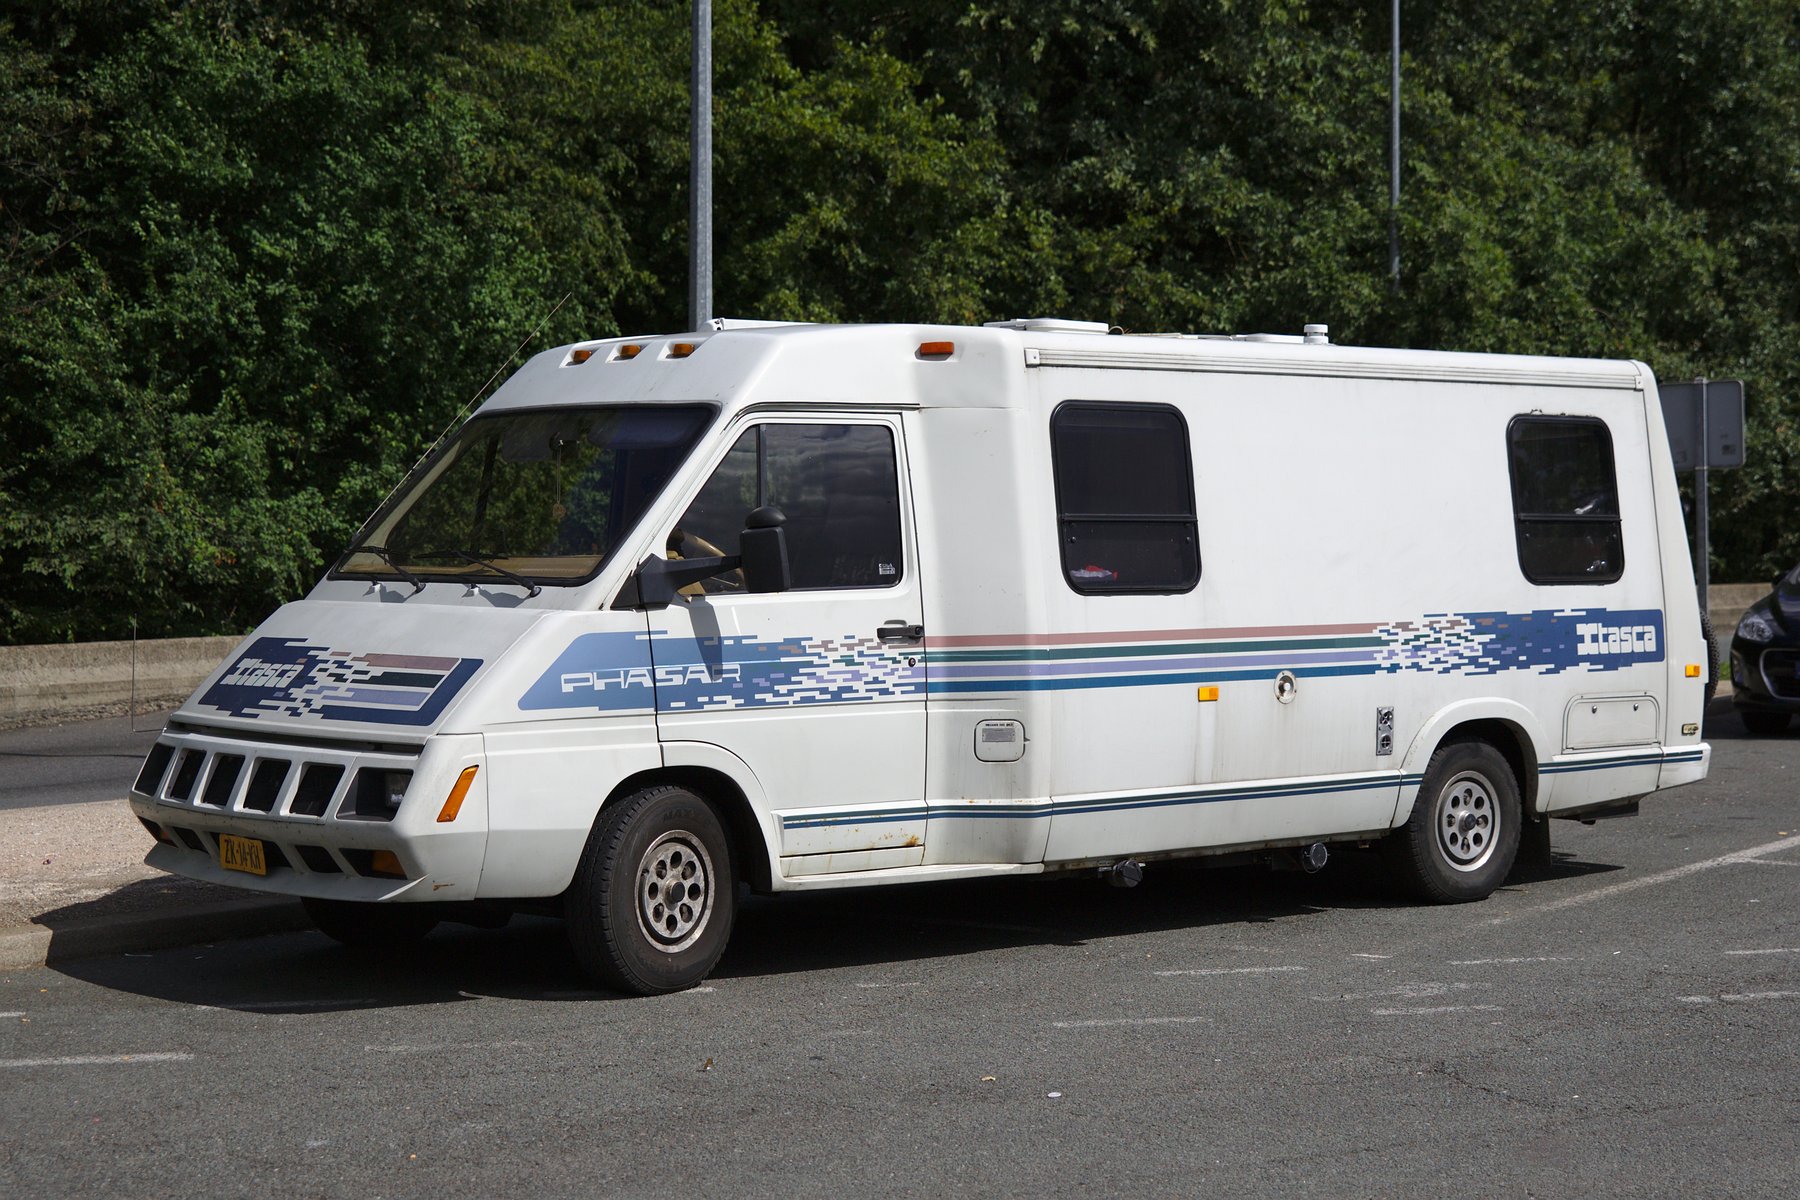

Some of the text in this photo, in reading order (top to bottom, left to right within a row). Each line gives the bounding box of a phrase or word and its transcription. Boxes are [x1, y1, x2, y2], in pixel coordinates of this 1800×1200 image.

[1576, 623, 1656, 655] Itasca
[220, 658, 304, 688] Itasca
[561, 663, 741, 692] PHASAR
